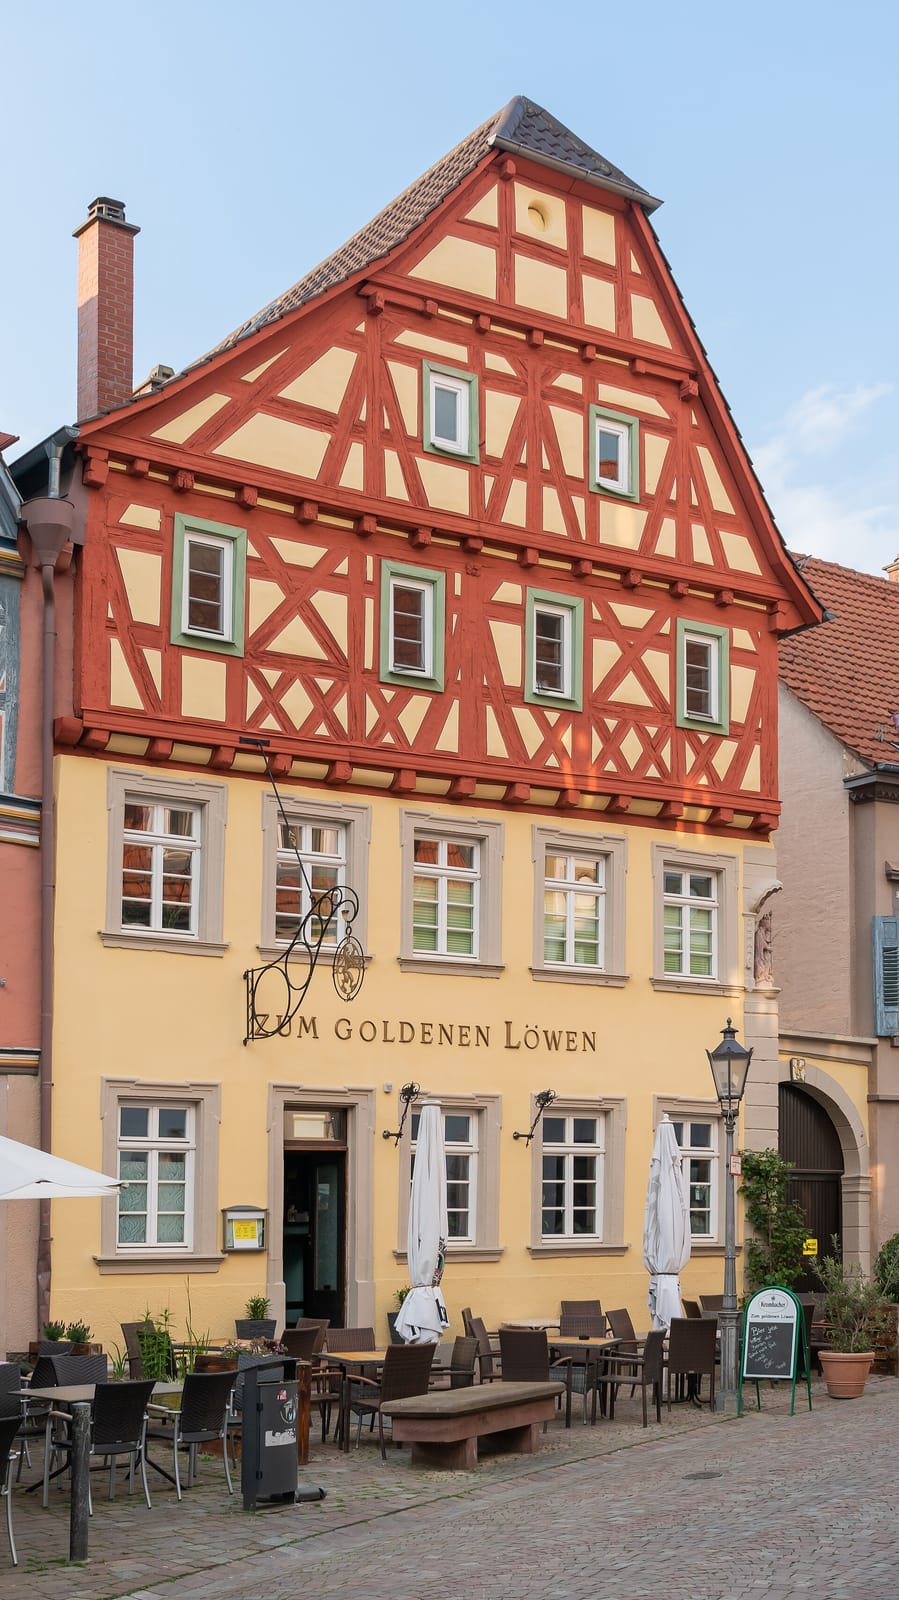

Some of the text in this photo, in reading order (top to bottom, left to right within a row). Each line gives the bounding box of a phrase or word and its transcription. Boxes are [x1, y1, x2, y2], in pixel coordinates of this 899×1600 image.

[254, 1014, 597, 1052] ZUM GOLDENEN LÖWEN
